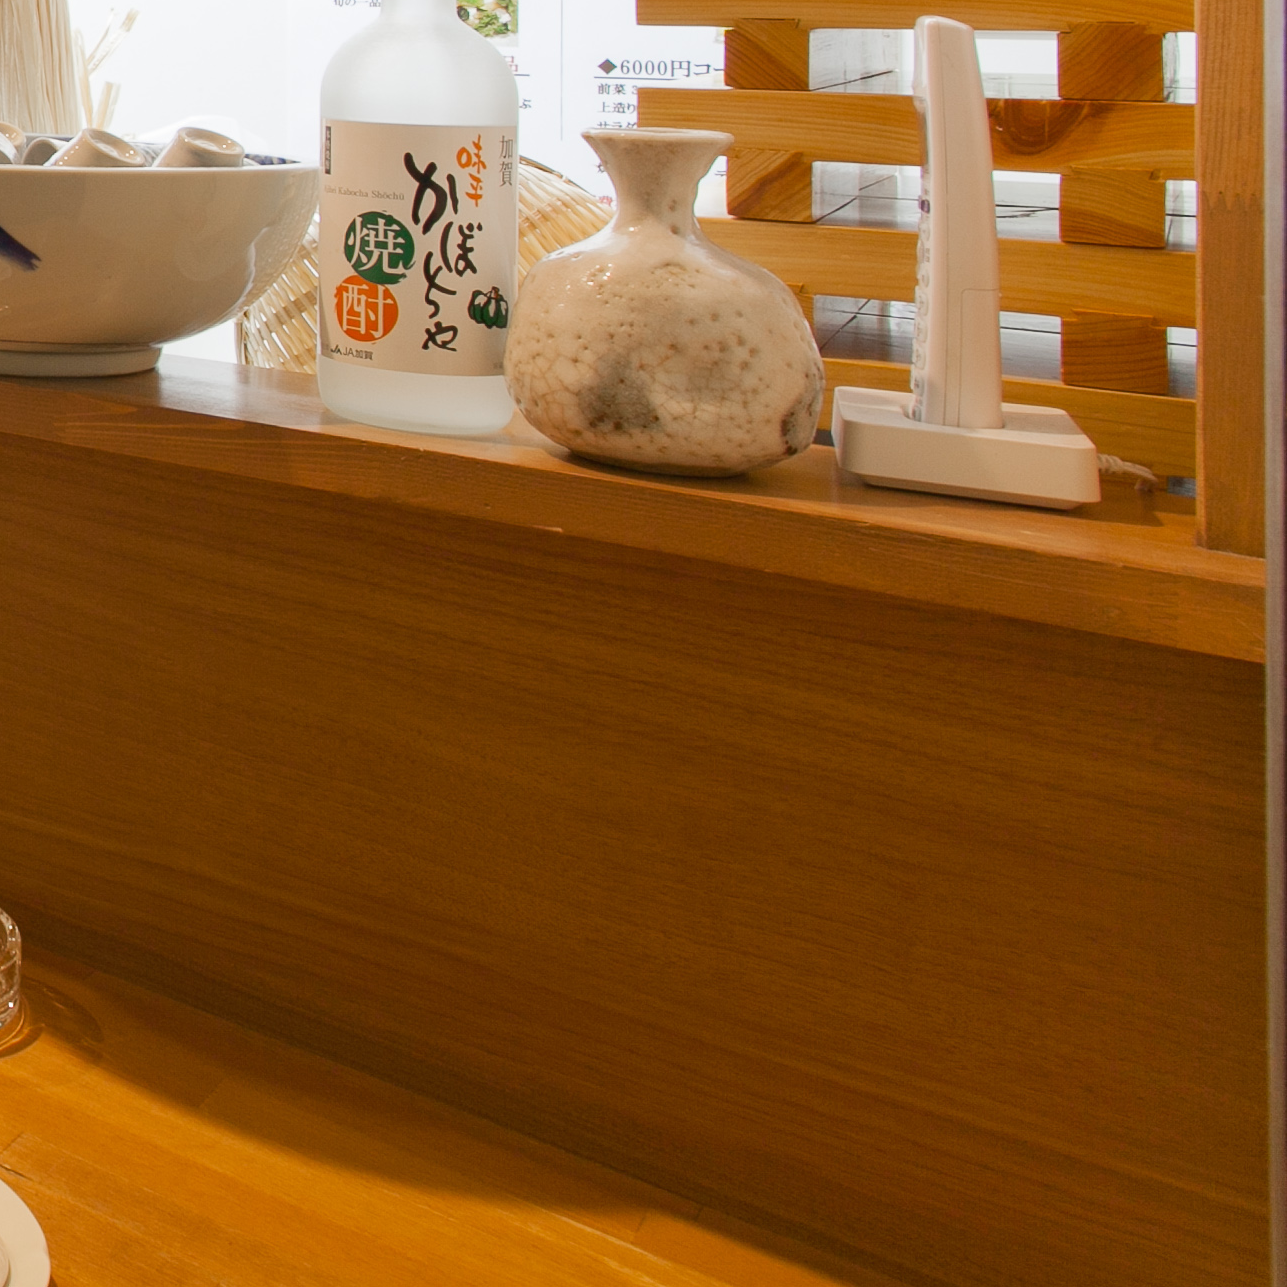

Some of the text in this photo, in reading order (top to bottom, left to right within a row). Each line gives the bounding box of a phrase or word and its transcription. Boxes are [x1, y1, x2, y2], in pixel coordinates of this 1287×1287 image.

[620, 60, 725, 78] 6000円コー
[456, 133, 486, 207] 味平
[498, 135, 514, 188] 加賀
[338, 186, 368, 197] Kabocha
